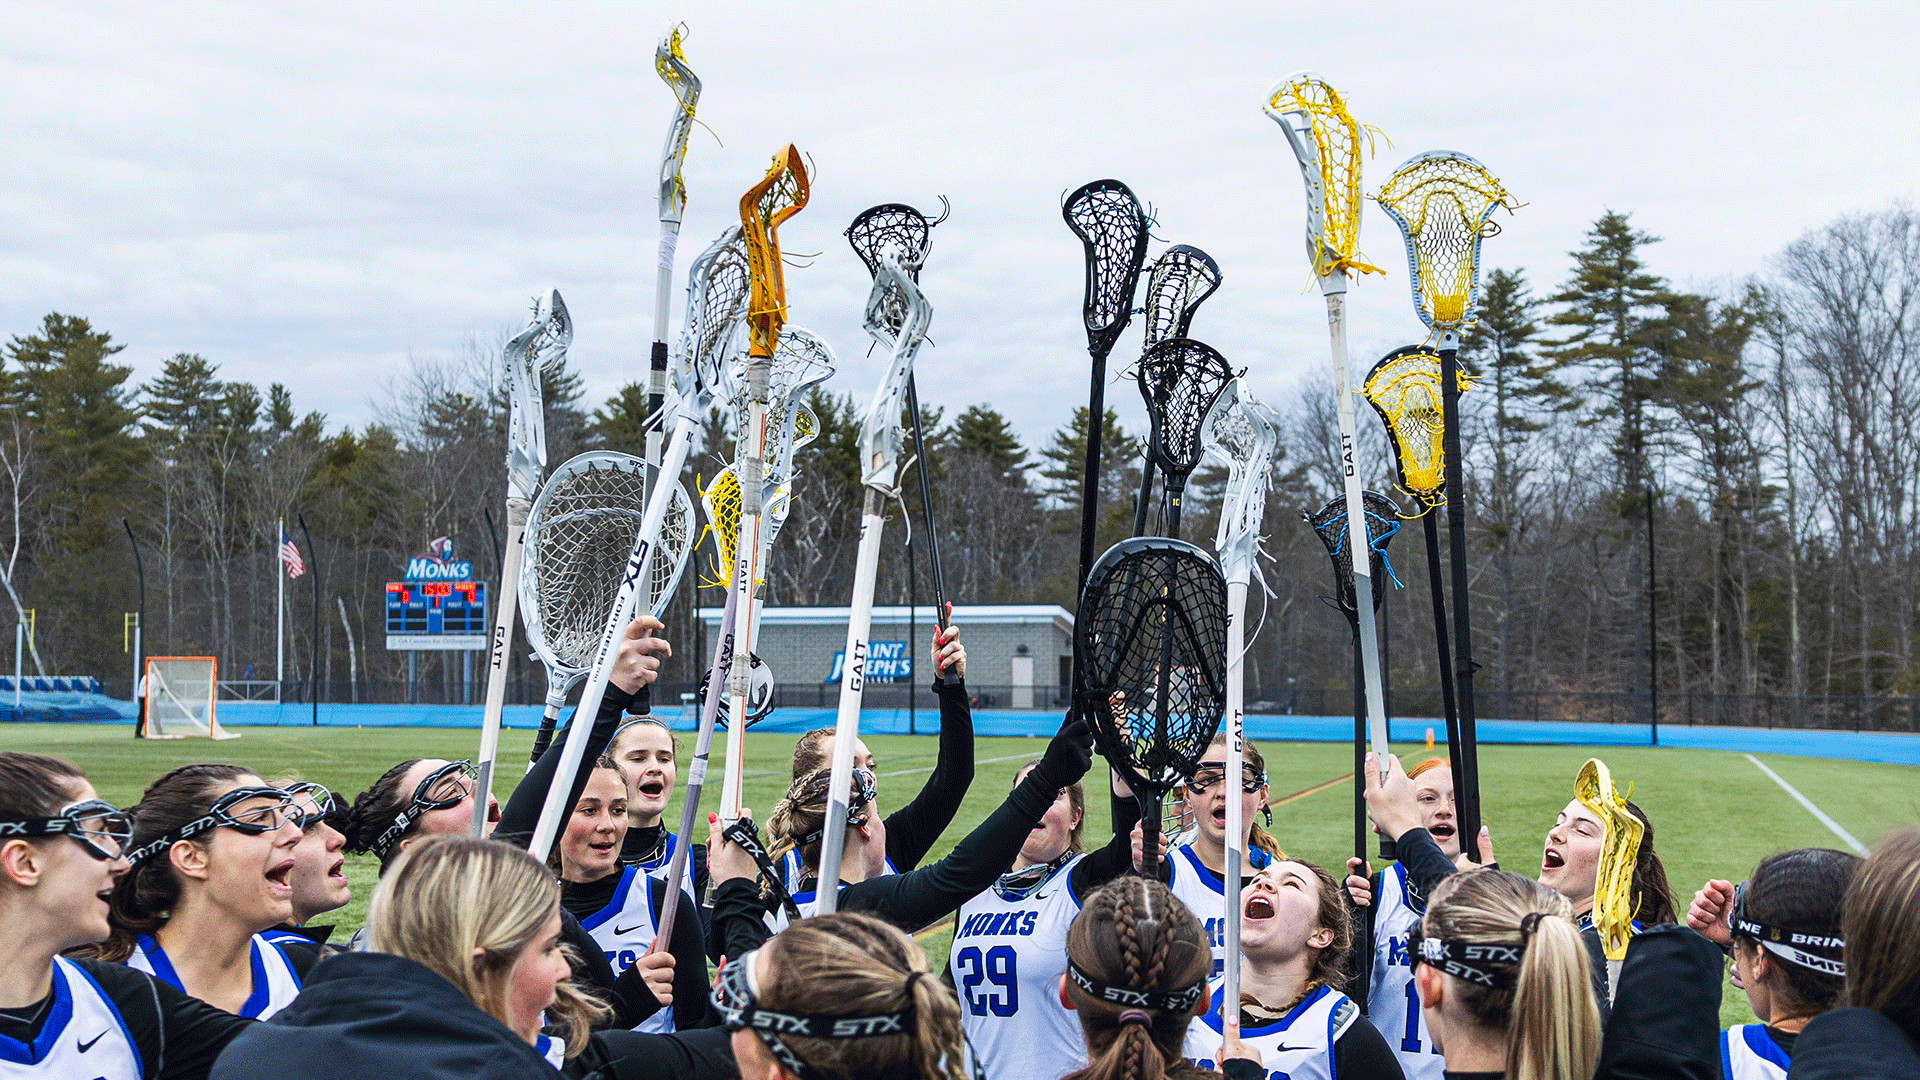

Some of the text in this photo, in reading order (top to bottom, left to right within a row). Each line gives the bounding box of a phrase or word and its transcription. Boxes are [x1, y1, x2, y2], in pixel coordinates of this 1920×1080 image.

[629, 460, 644, 469] STX
[1342, 432, 1354, 477] GAIT
[1172, 498, 1180, 506] 10
[406, 558, 470, 579] MONKS
[623, 539, 649, 592] STX
[739, 560, 748, 593] GAIT
[493, 626, 505, 669] GAIT
[719, 634, 732, 671] GAIT
[866, 643, 903, 658] AINT
[831, 653, 910, 680] JEPH'S
[851, 639, 866, 691] GAIT
[0, 821, 27, 834] TX
[730, 831, 764, 858] STX
[1060, 849, 1073, 864] STX
[957, 910, 1038, 939] MONKS
[1577, 912, 1592, 925] TX
[1791, 933, 1845, 948] BRIN
[1465, 946, 1519, 961] STX
[957, 945, 1018, 1017] 29
[1070, 966, 1093, 993] STX
[1445, 961, 1493, 985] STX
[1104, 987, 1149, 1006] STX
[752, 1010, 810, 1035] STX
[832, 1014, 901, 1036] STX
